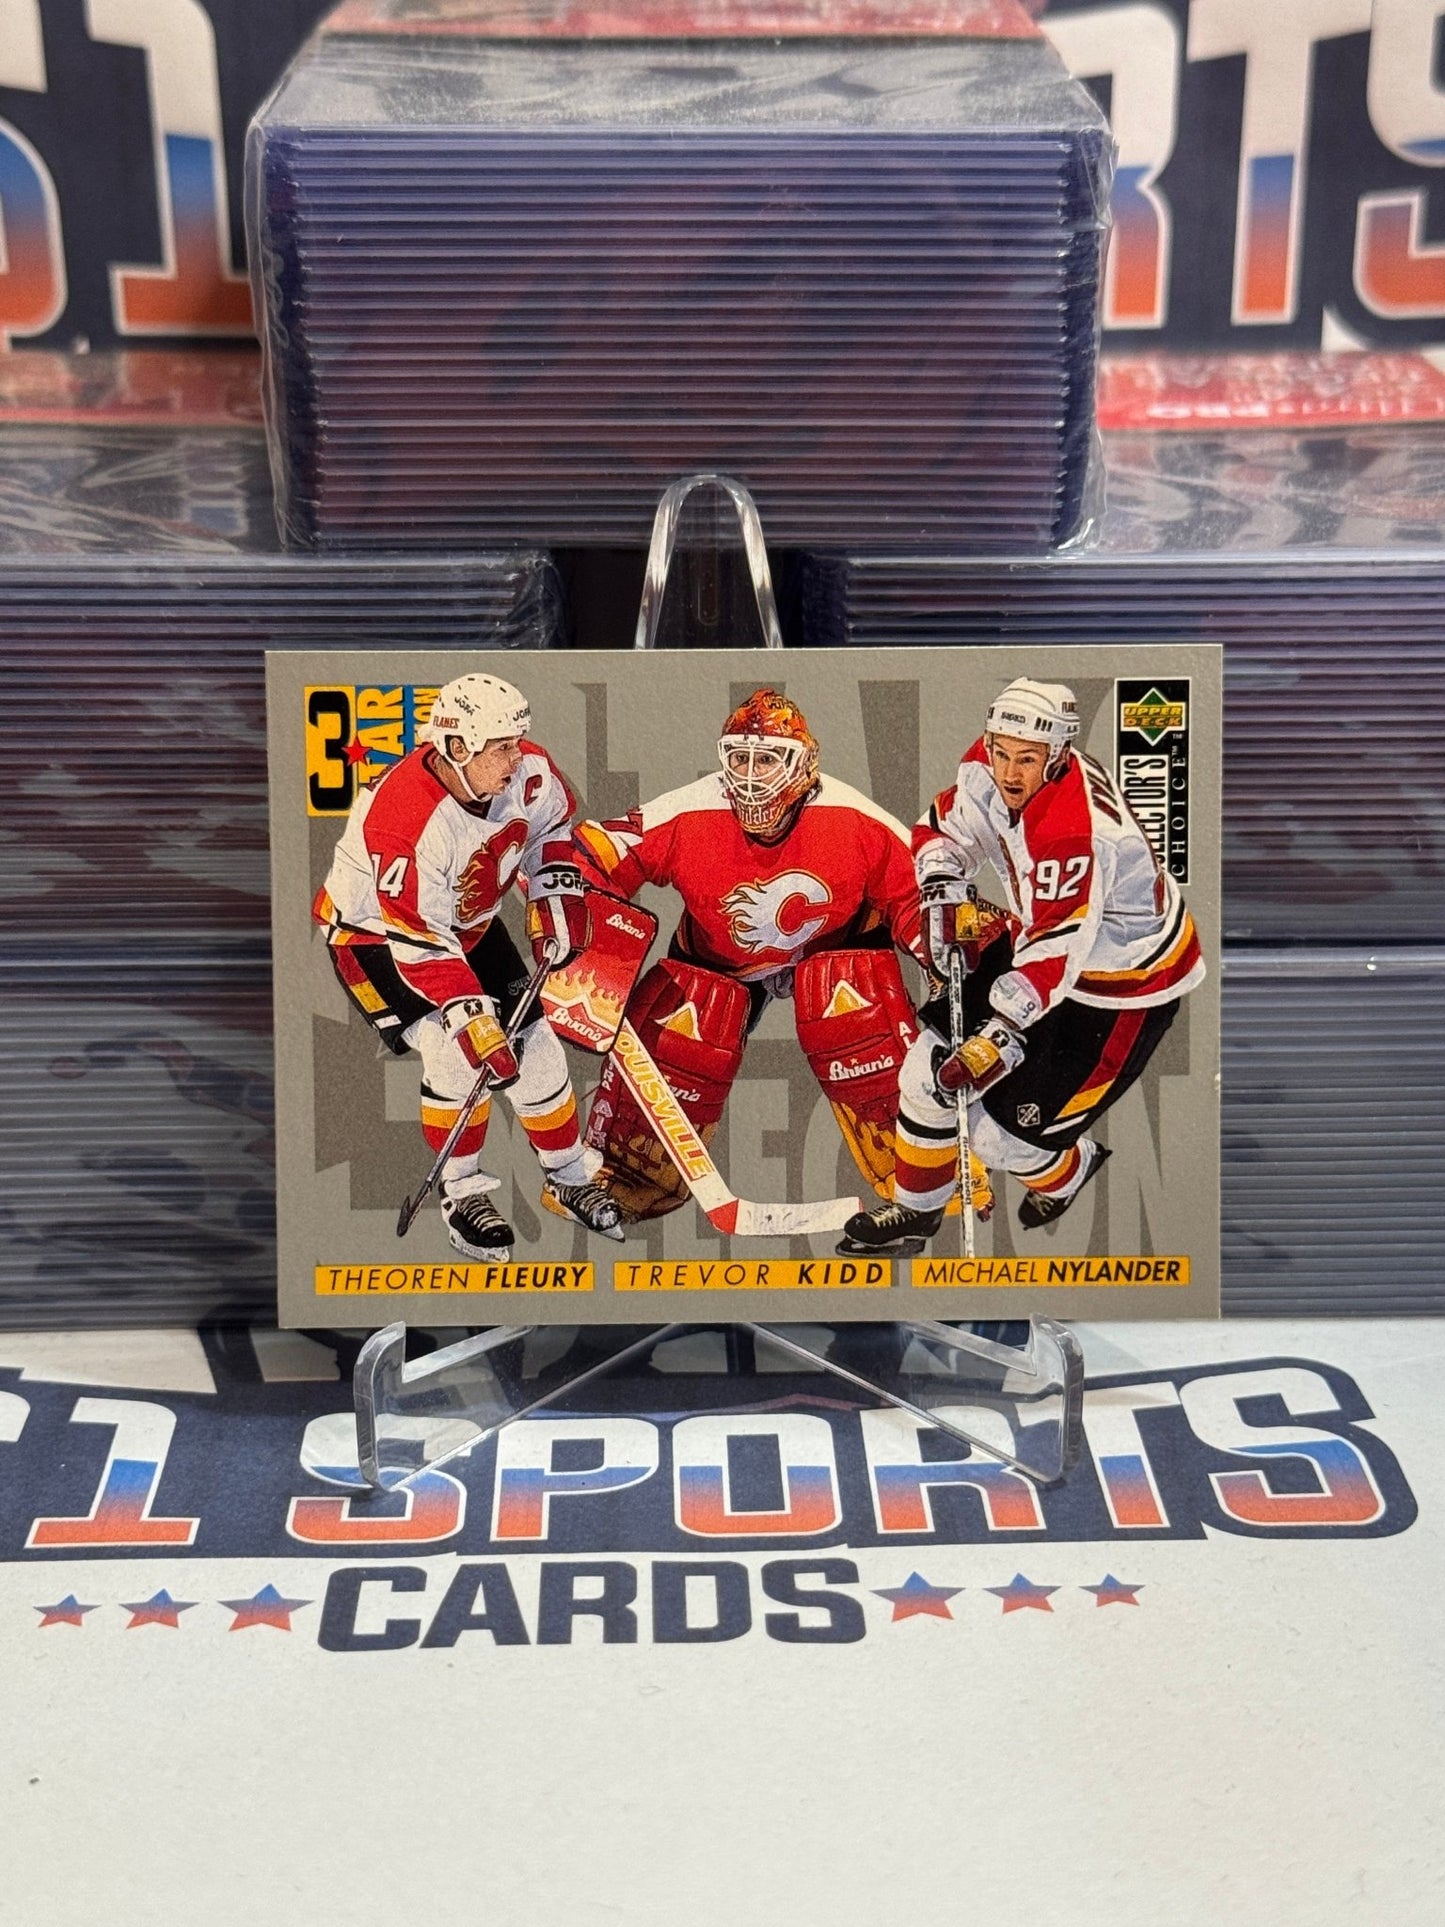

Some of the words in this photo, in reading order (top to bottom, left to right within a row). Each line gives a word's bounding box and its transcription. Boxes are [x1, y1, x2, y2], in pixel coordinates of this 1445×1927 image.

[1124, 706, 1184, 717] UPPER
[309, 691, 353, 810] 3
[1171, 757, 1186, 877] CHOICE
[1034, 856, 1090, 901] 92
[548, 1008, 603, 1042] Brian's
[829, 1054, 895, 1081] Brian's
[613, 1031, 714, 1180] OUISVILLE
[329, 1268, 469, 1291] THEOREN
[485, 1266, 588, 1289] FLEURY
[628, 1265, 770, 1287] TREVOR
[798, 1263, 883, 1284] KIDD
[924, 1261, 1038, 1283] MICHAEL
[1047, 1260, 1181, 1282] NYLANDER
[0, 1391, 202, 1549] 1
[285, 1366, 1387, 1546] SPORTS
[317, 1556, 867, 1653] CARDS
